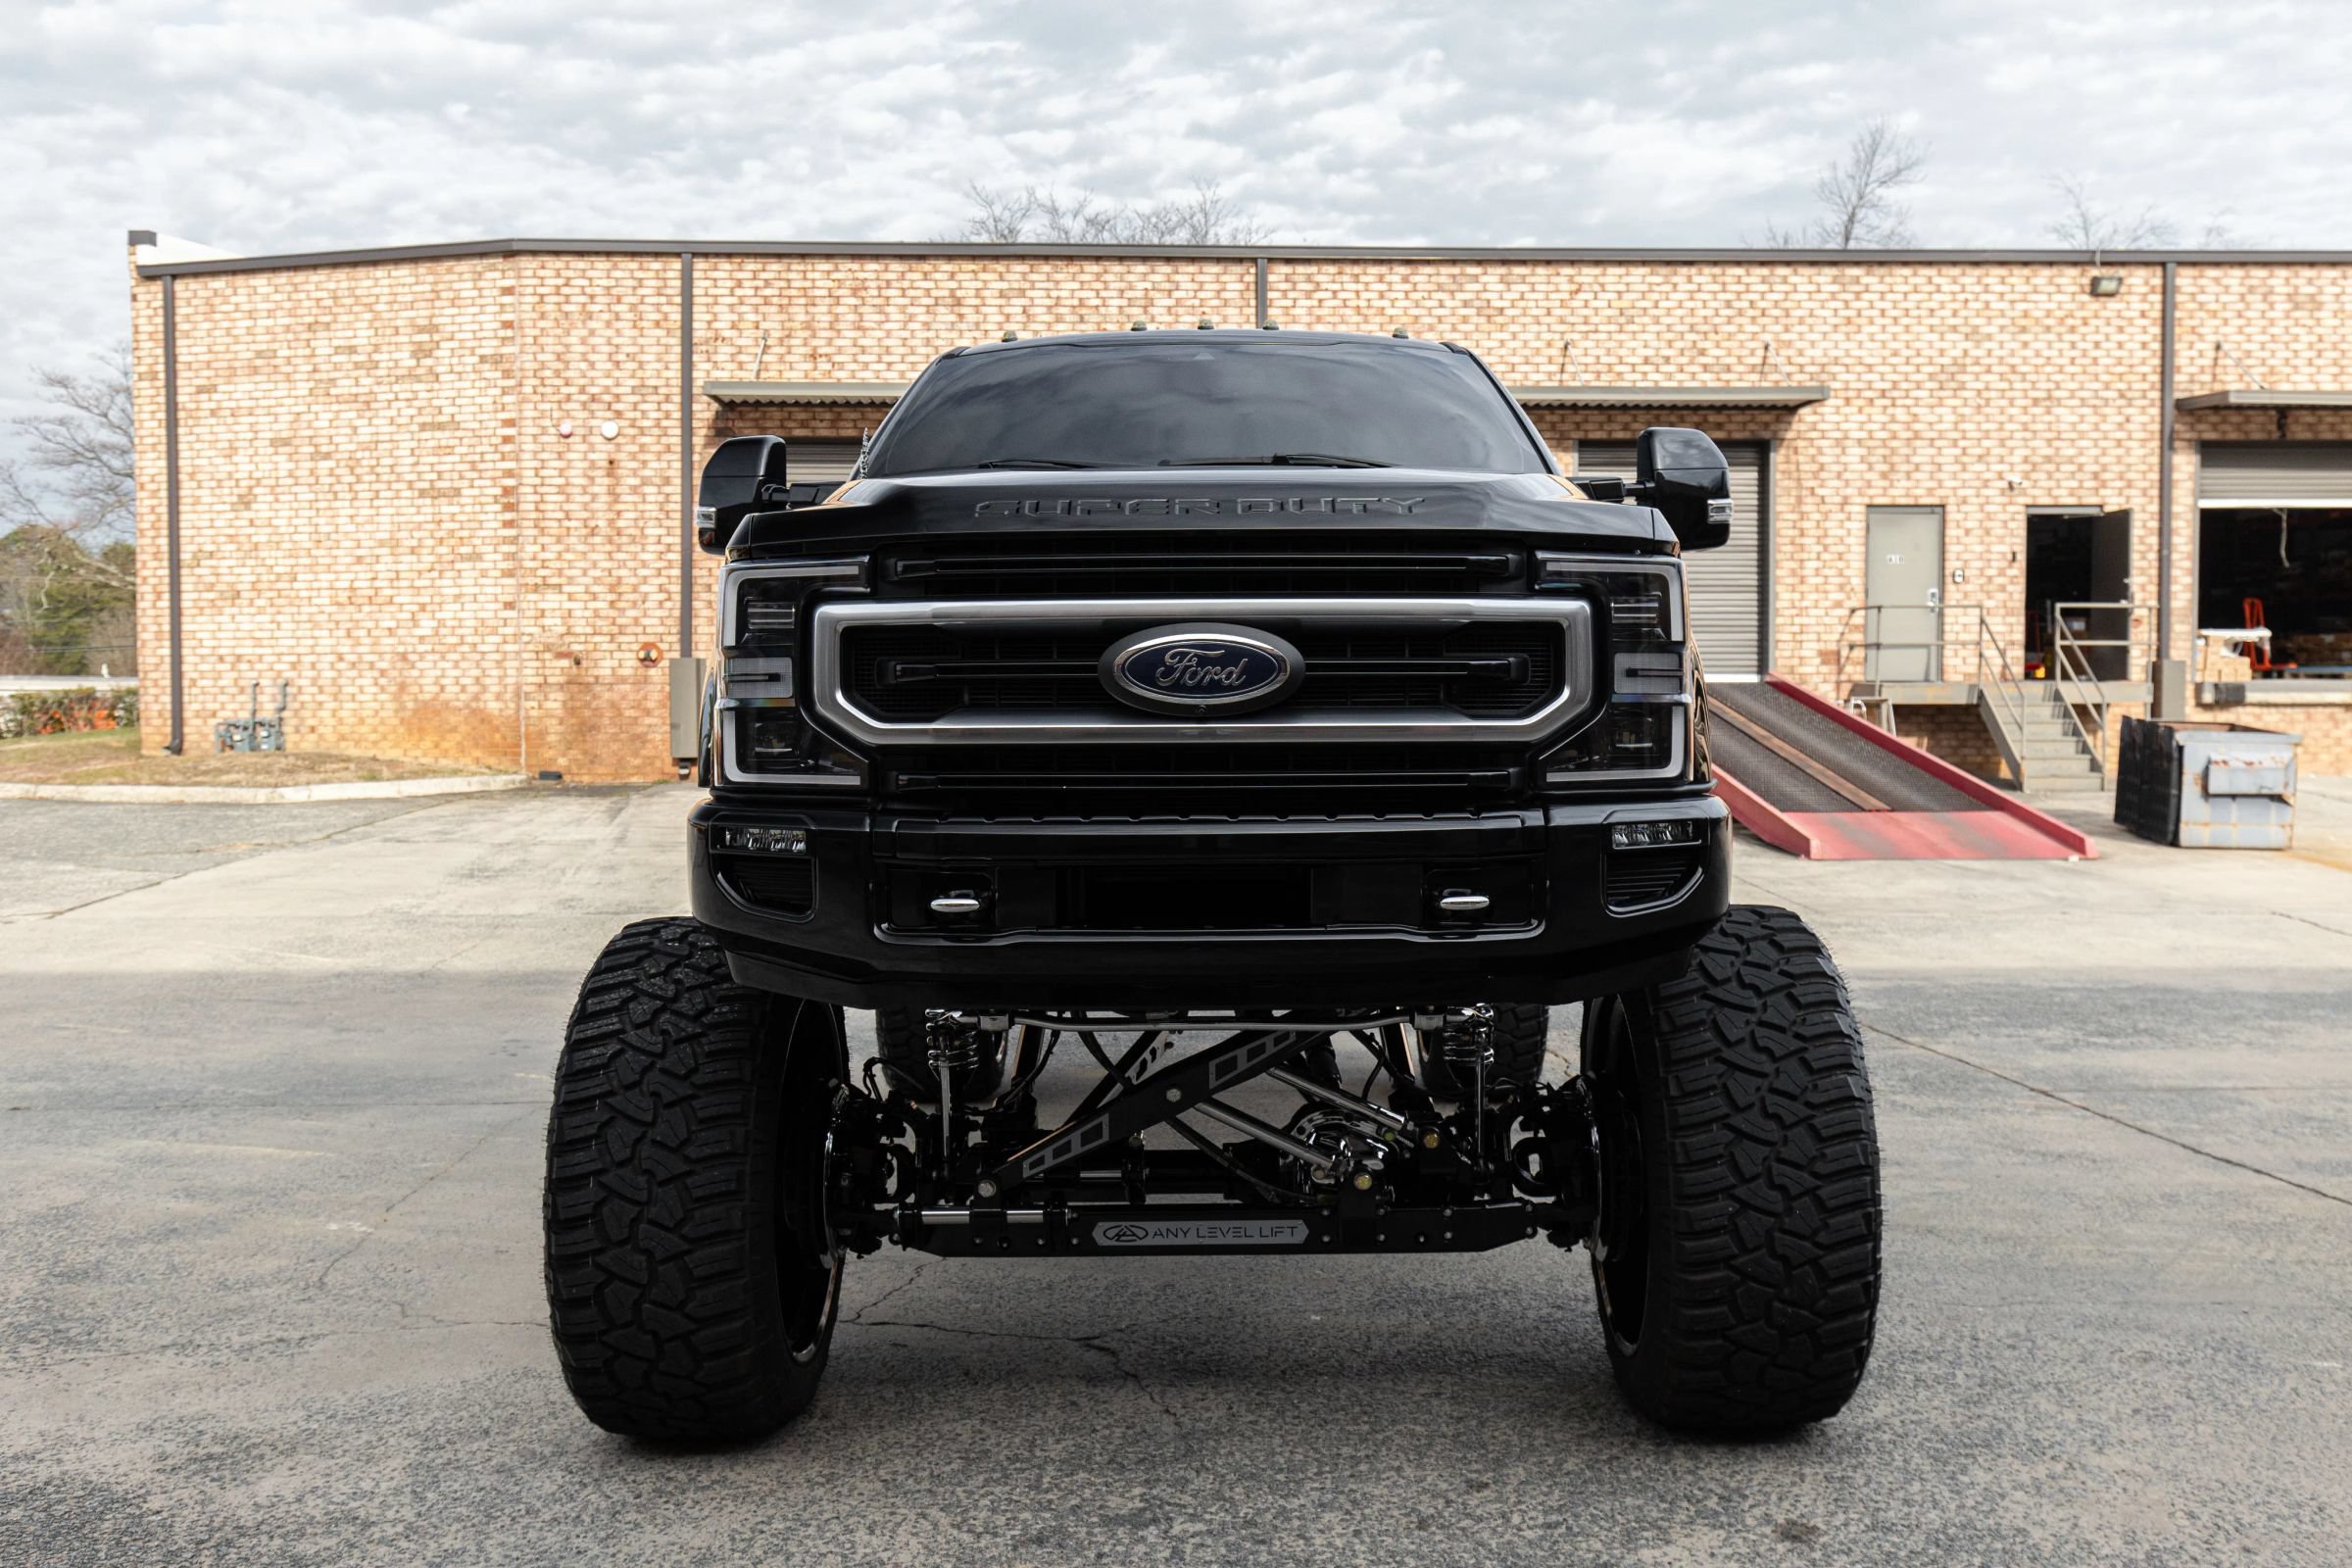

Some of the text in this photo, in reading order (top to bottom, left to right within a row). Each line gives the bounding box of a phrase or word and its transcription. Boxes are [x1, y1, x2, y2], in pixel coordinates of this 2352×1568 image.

[975, 497, 1426, 518] SUPER DUTY
[1154, 647, 1249, 687] Ford
[1152, 1225, 1298, 1240] ANY LEVEL LIFT
